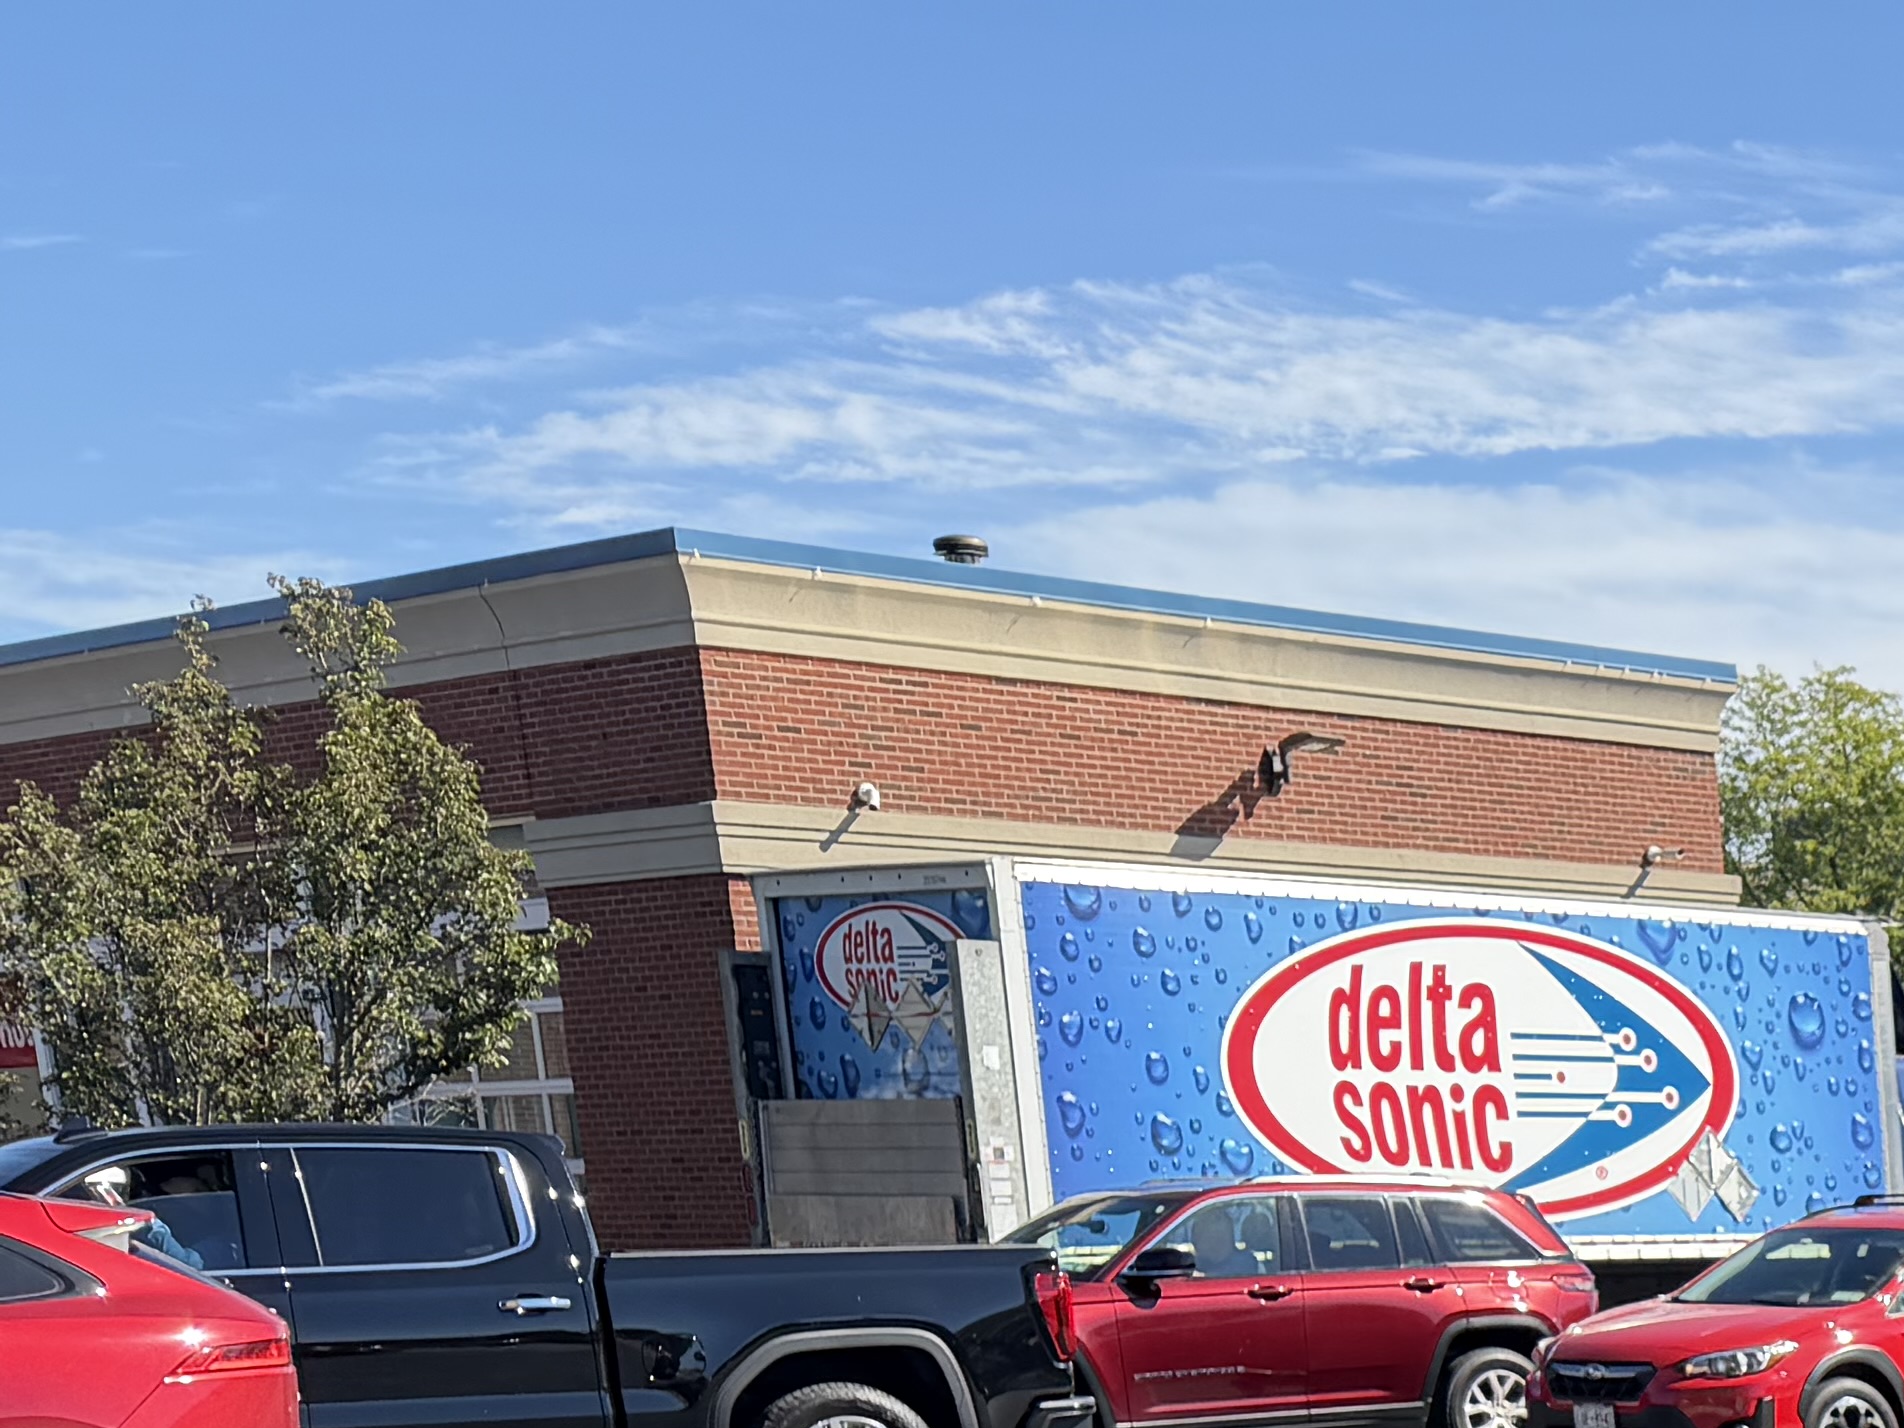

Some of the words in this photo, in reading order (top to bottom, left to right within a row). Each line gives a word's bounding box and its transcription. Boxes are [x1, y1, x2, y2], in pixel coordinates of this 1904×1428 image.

[842, 919, 895, 965] delta
[1328, 961, 1502, 1073] delta
[1333, 1080, 1513, 1174] sonic
